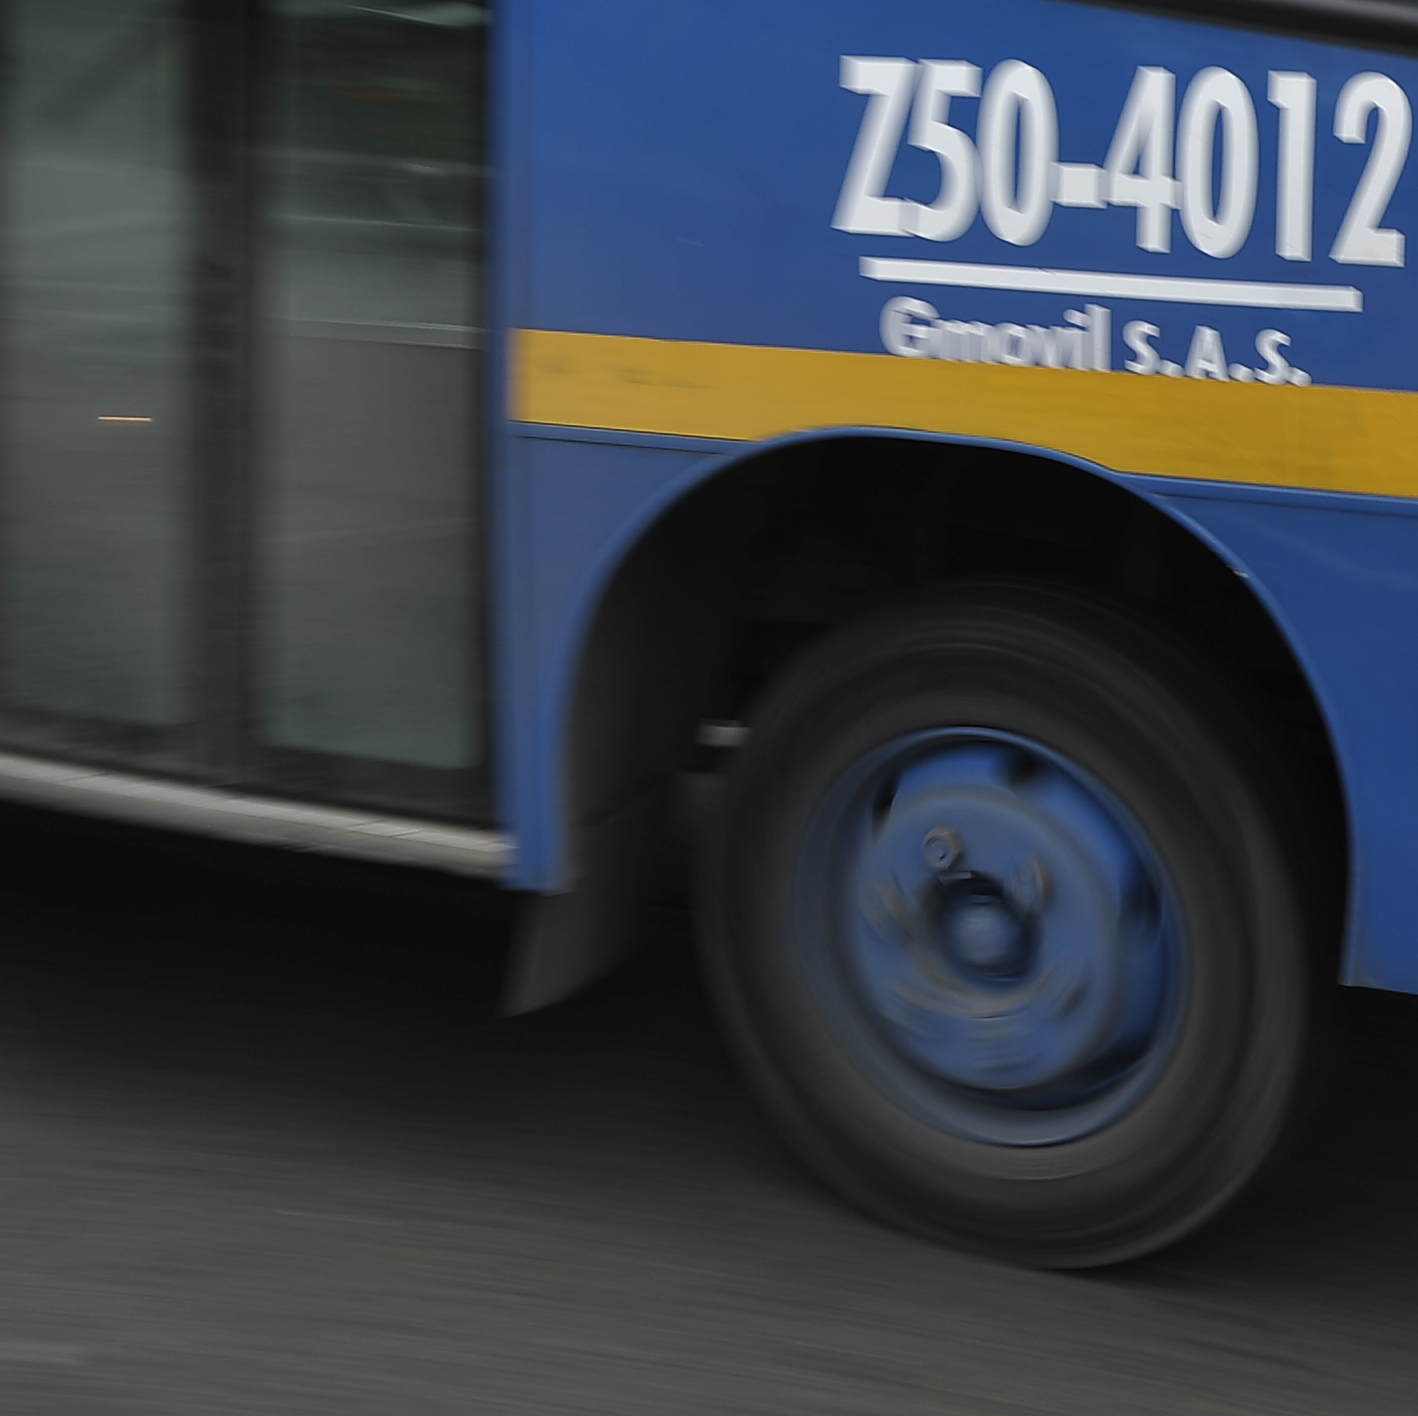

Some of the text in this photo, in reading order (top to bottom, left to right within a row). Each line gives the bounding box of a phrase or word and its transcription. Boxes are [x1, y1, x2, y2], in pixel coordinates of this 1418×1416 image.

[831, 54, 1413, 268] Z50-4012
[880, 295, 1312, 386] Gmovil S.A.S.
